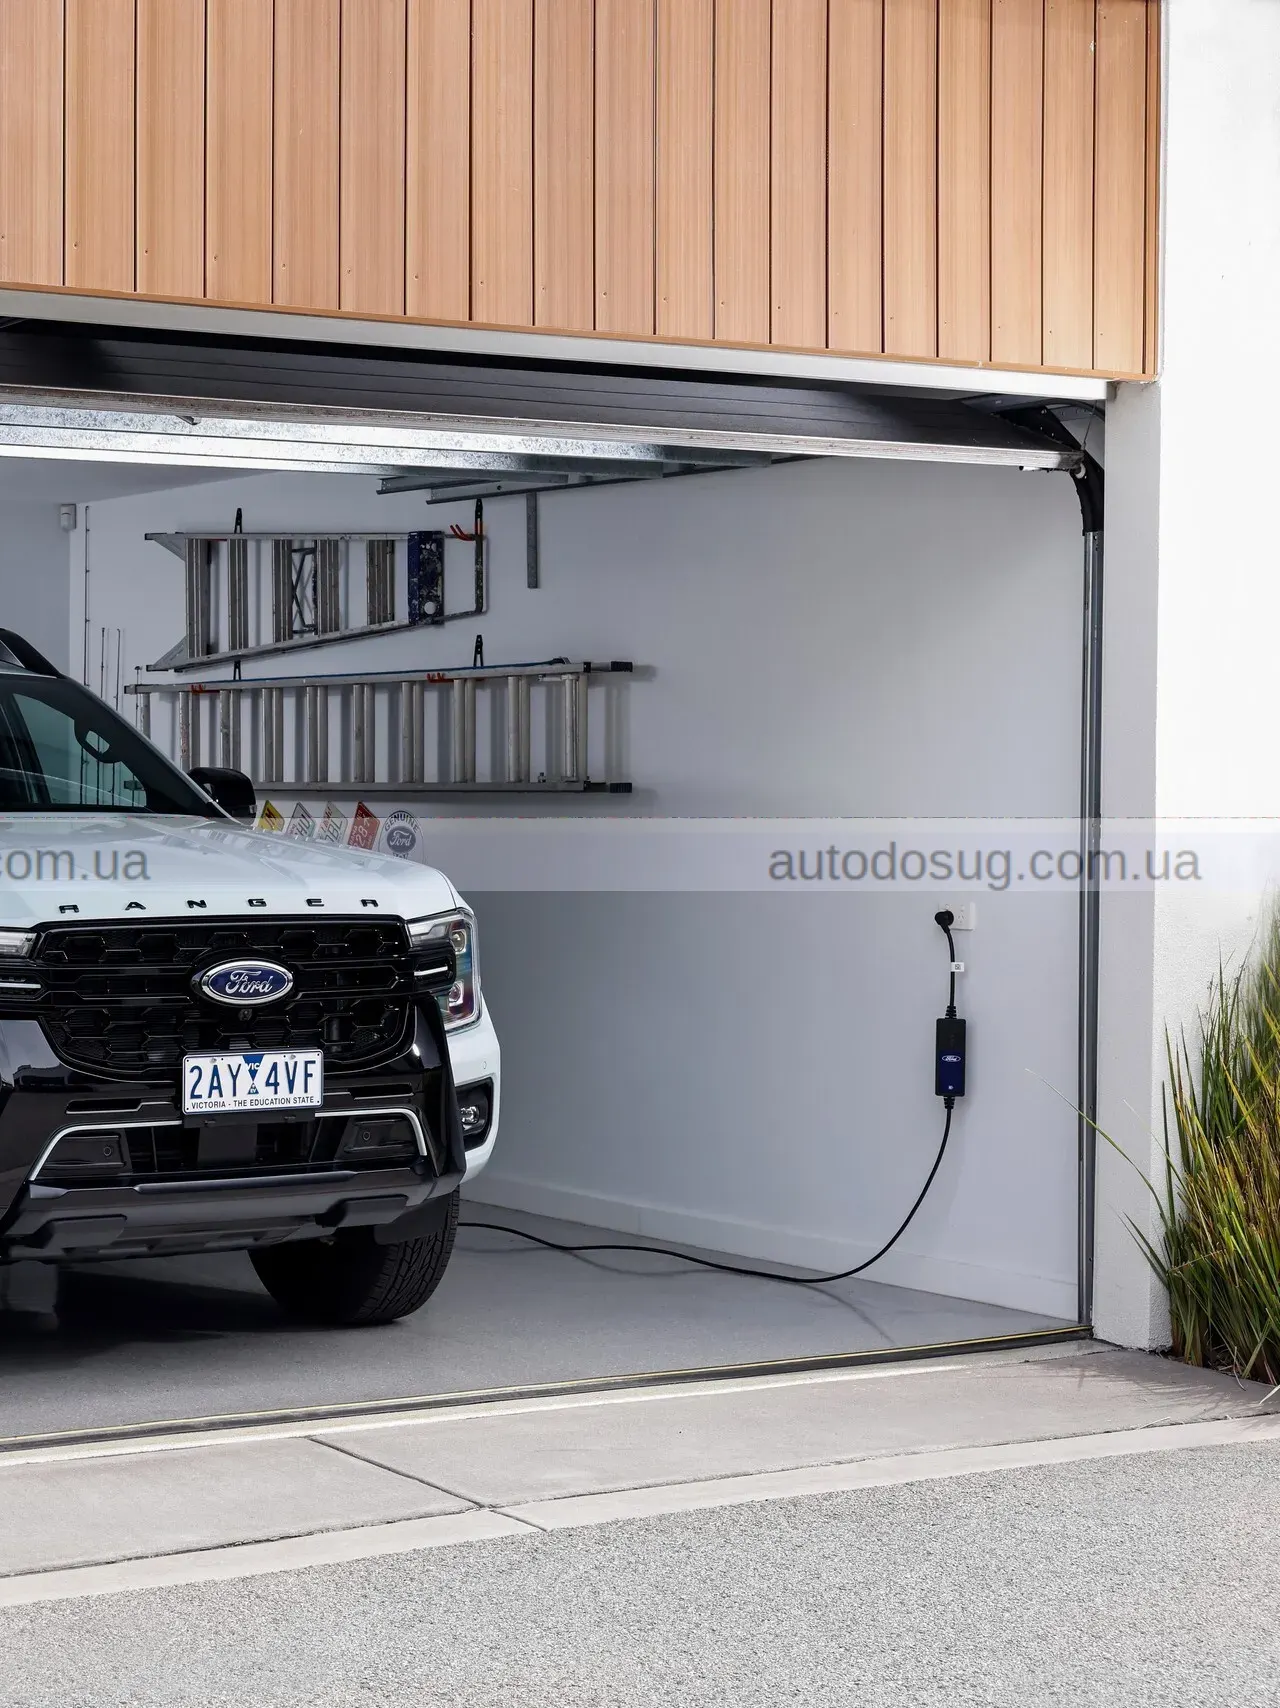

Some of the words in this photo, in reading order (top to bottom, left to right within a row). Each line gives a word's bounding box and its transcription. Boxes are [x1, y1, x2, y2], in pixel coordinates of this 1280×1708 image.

[384, 812, 420, 834] GENUINE
[389, 830, 413, 846] Ford
[58, 898, 379, 914] RANGER
[225, 970, 273, 994] Ford
[246, 1063, 261, 1071] VIC
[189, 1063, 242, 1100] 2AY
[265, 1060, 317, 1095] 4VF
[191, 1100, 226, 1110] VICTORIA
[233, 1099, 248, 1108] THE
[249, 1097, 291, 1107] EDUCATION
[293, 1095, 314, 1104] STATE
